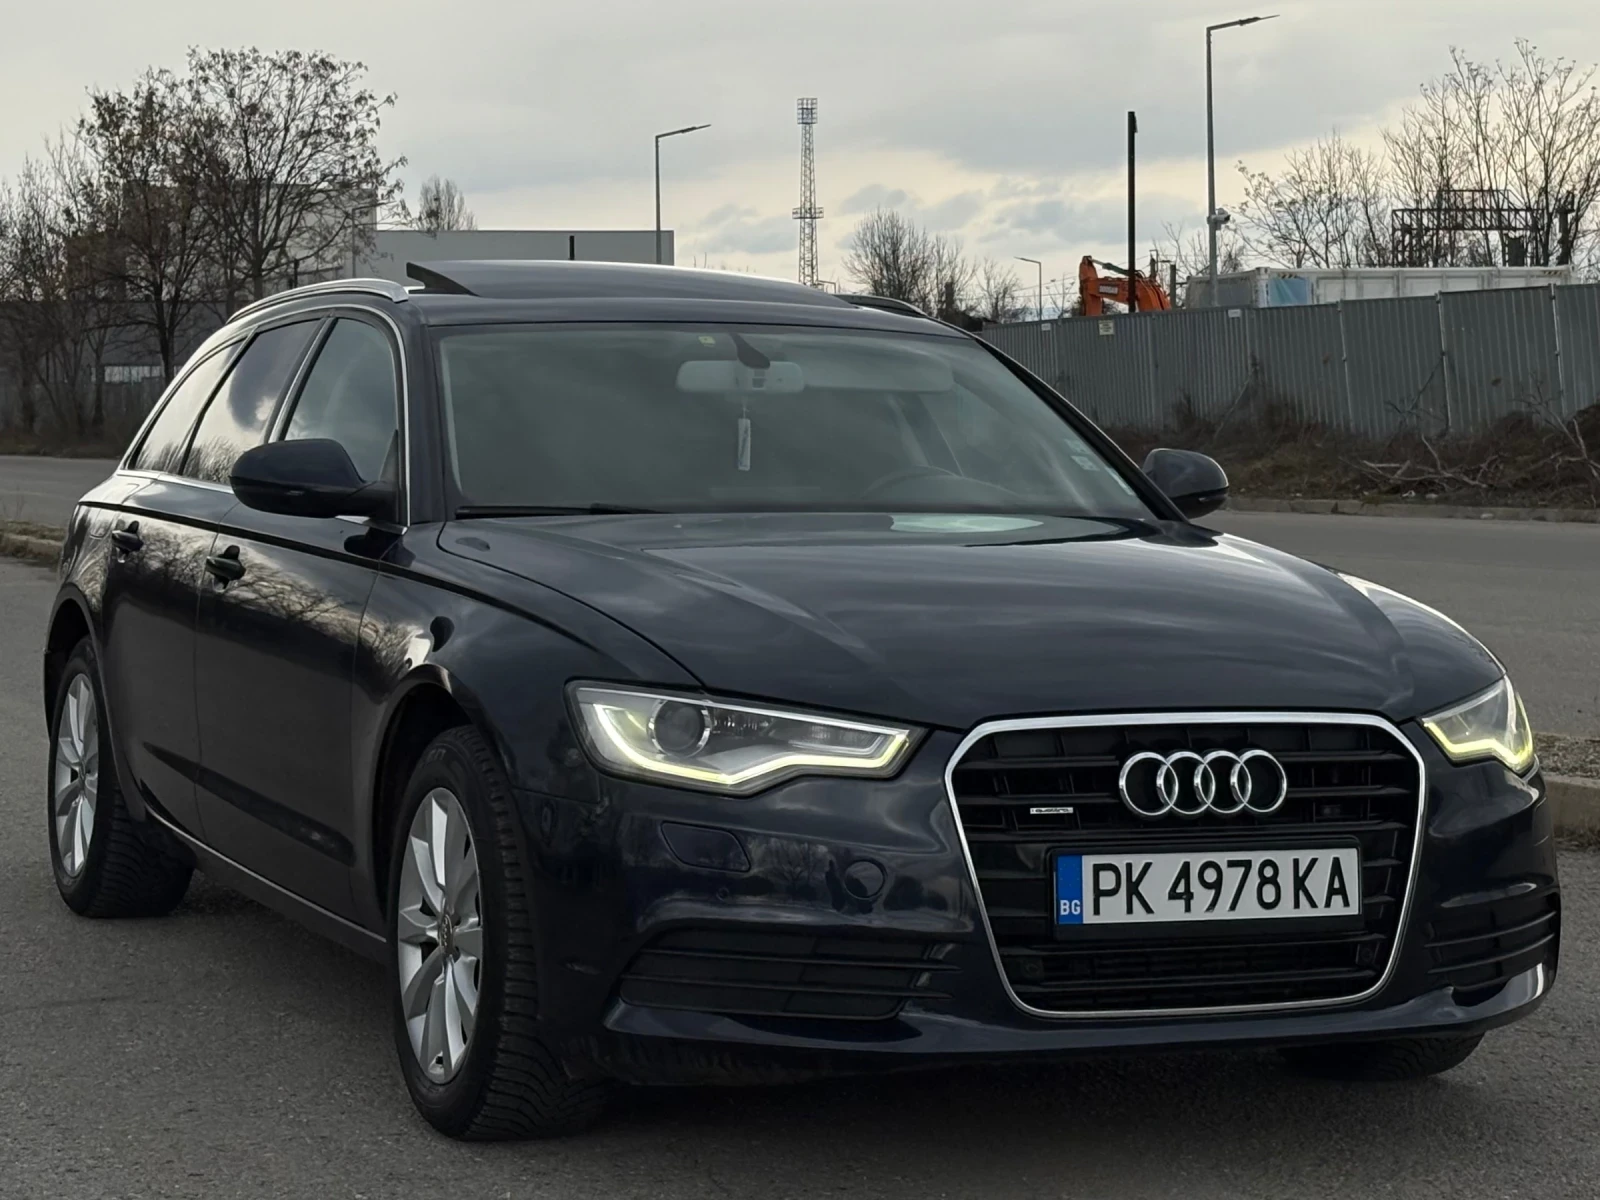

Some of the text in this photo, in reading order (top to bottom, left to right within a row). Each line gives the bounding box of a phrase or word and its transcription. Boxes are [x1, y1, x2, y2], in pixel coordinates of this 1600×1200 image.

[1092, 857, 1351, 916] PK 4978 KA
[1060, 900, 1081, 916] BG
